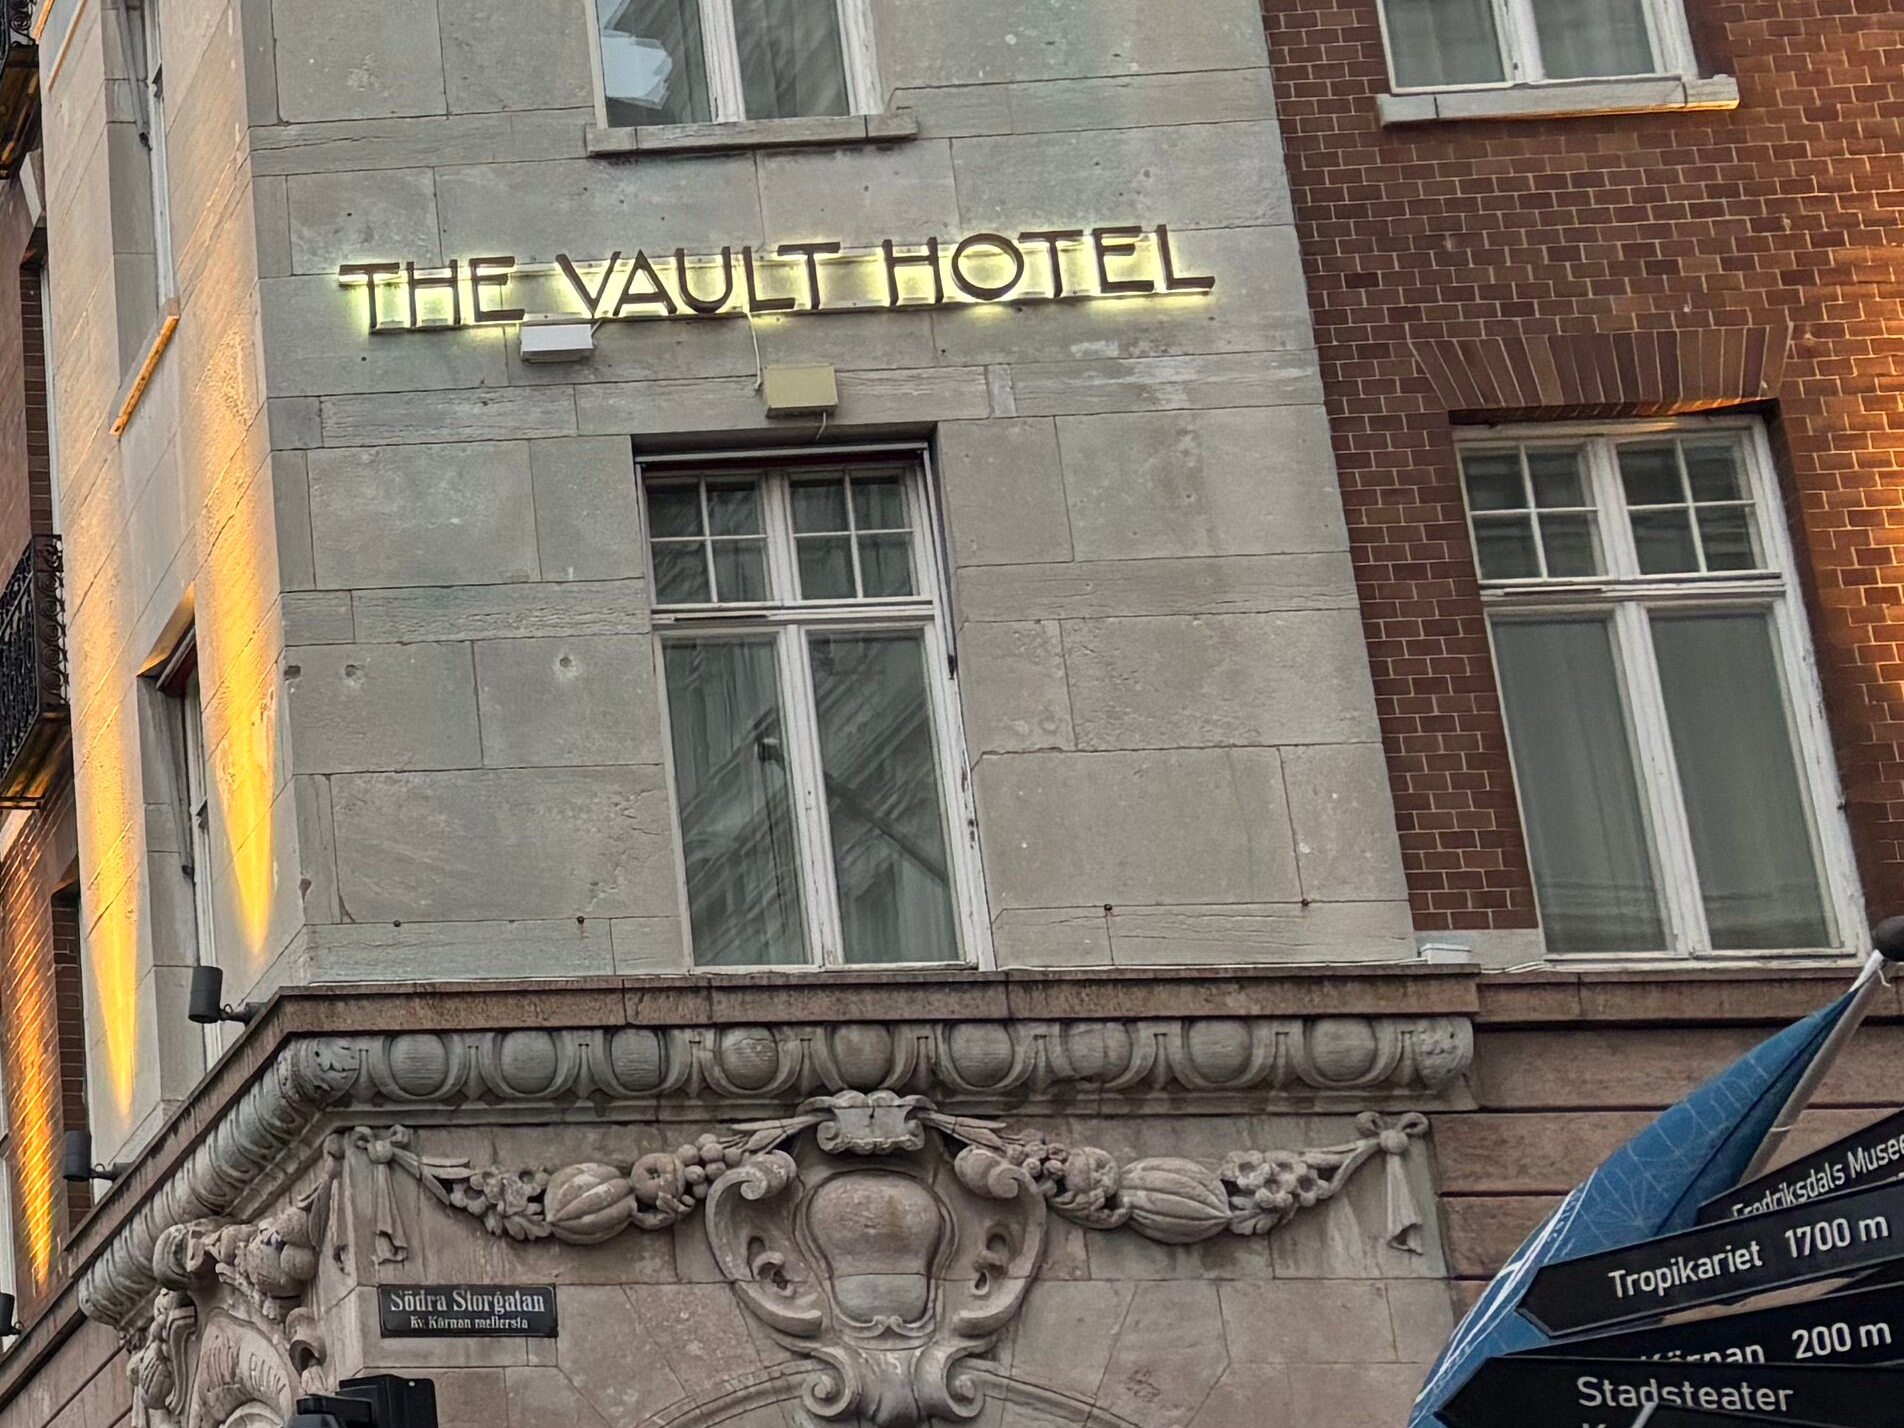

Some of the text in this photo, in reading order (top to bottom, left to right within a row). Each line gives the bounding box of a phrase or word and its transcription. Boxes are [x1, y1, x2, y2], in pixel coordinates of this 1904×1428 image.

[338, 224, 1215, 332] THE VAULT HOTEL
[1608, 1215, 1890, 1298] Tropikariet 1700 m
[390, 1288, 545, 1315] Södra Storgatan
[1792, 1323, 1852, 1359] 200
[1859, 1322, 1892, 1348] m
[1576, 1375, 1794, 1412] Stadsteater
